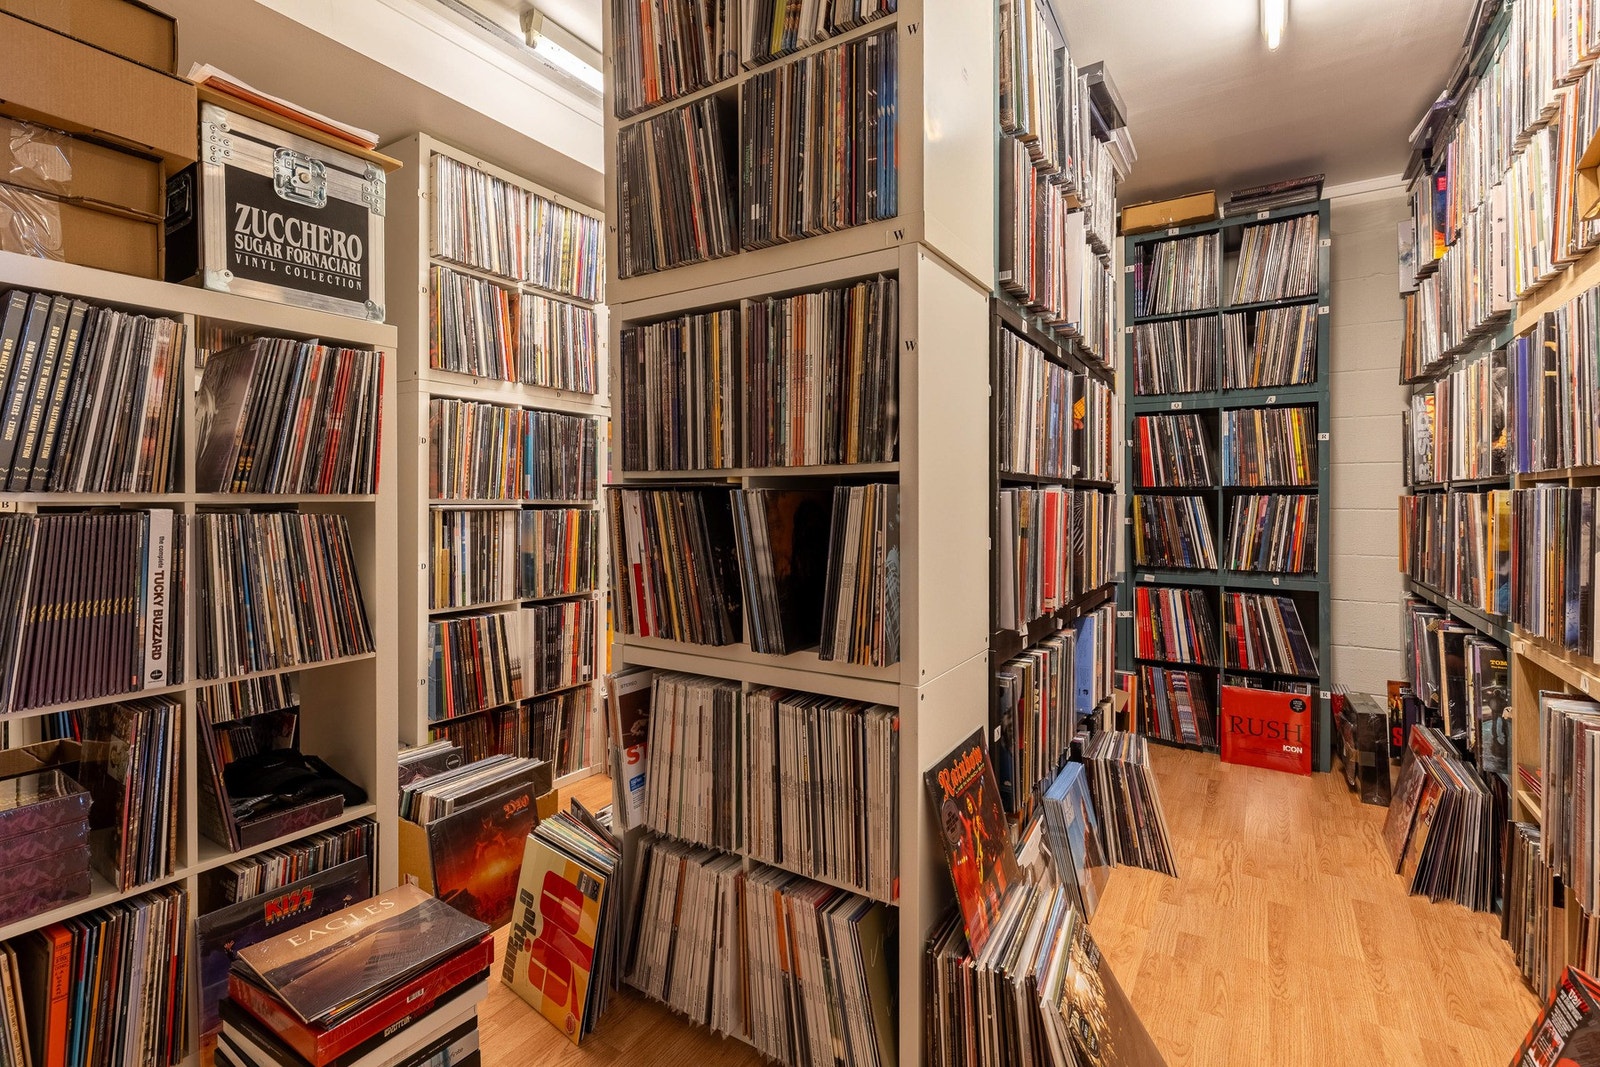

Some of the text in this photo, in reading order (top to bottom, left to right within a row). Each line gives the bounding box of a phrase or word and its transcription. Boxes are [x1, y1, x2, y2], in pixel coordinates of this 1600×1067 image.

[907, 22, 919, 35] W
[234, 202, 363, 262] ZUCCHERO
[893, 228, 905, 241] W
[234, 233, 362, 278] SUGAR FORNACIARI
[235, 253, 362, 291] VINYL COLLECTION
[51, 326, 60, 337] BOB
[69, 329, 78, 340] BOB
[4, 338, 13, 350] BOB
[27, 341, 36, 351] BOB
[45, 338, 58, 359] MARLEY
[64, 341, 76, 361] MARLEY
[905, 340, 917, 351] W
[21, 353, 34, 374] MARLEY
[41, 366, 51, 376] THE
[60, 368, 70, 378] THE
[16, 382, 26, 392] THE
[36, 377, 49, 399] WAILERS
[54, 379, 67, 401] WAILERS
[10, 393, 24, 416] WAILERS
[28, 404, 42, 432] RASTAMAN
[47, 406, 60, 432] RASTAMAN
[4, 421, 16, 441] EXODUS
[22, 433, 35, 458] VIBRATION
[41, 433, 54, 460] VIBRATION
[1, 501, 9, 509] B
[153, 570, 164, 606] TUCKY
[152, 609, 163, 660] BUZZARD
[1228, 714, 1304, 744] RUSH
[1282, 744, 1303, 754] ICON
[937, 745, 983, 802] Rainbow
[264, 884, 315, 923] KISS
[287, 898, 395, 947] EAGLES
